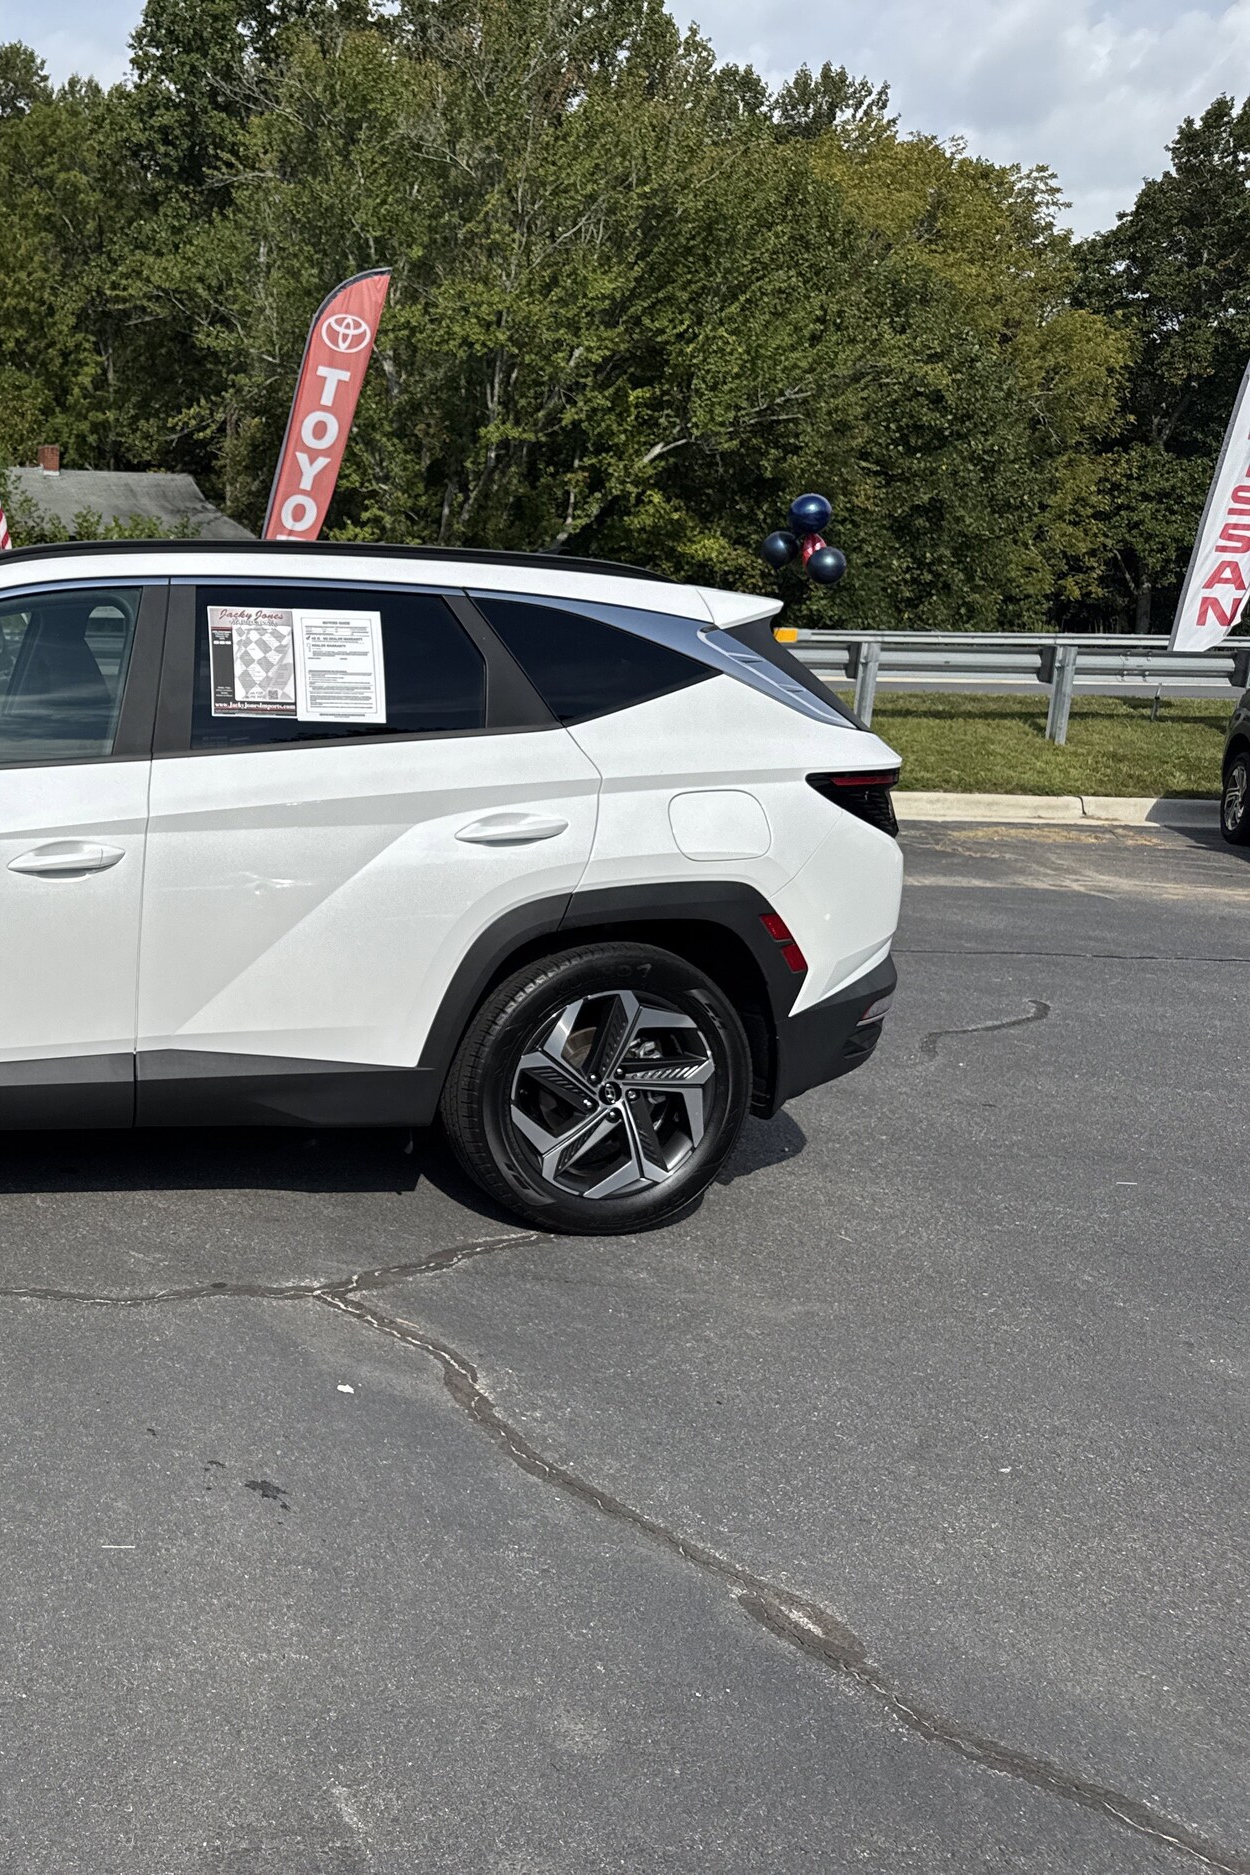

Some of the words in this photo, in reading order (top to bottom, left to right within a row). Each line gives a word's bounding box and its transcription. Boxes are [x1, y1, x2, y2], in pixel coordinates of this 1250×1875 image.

[276, 365, 351, 541] TOYO
[1196, 430, 1250, 627] SSAN
[219, 608, 253, 620] Jacky
[255, 610, 284, 621] Jones
